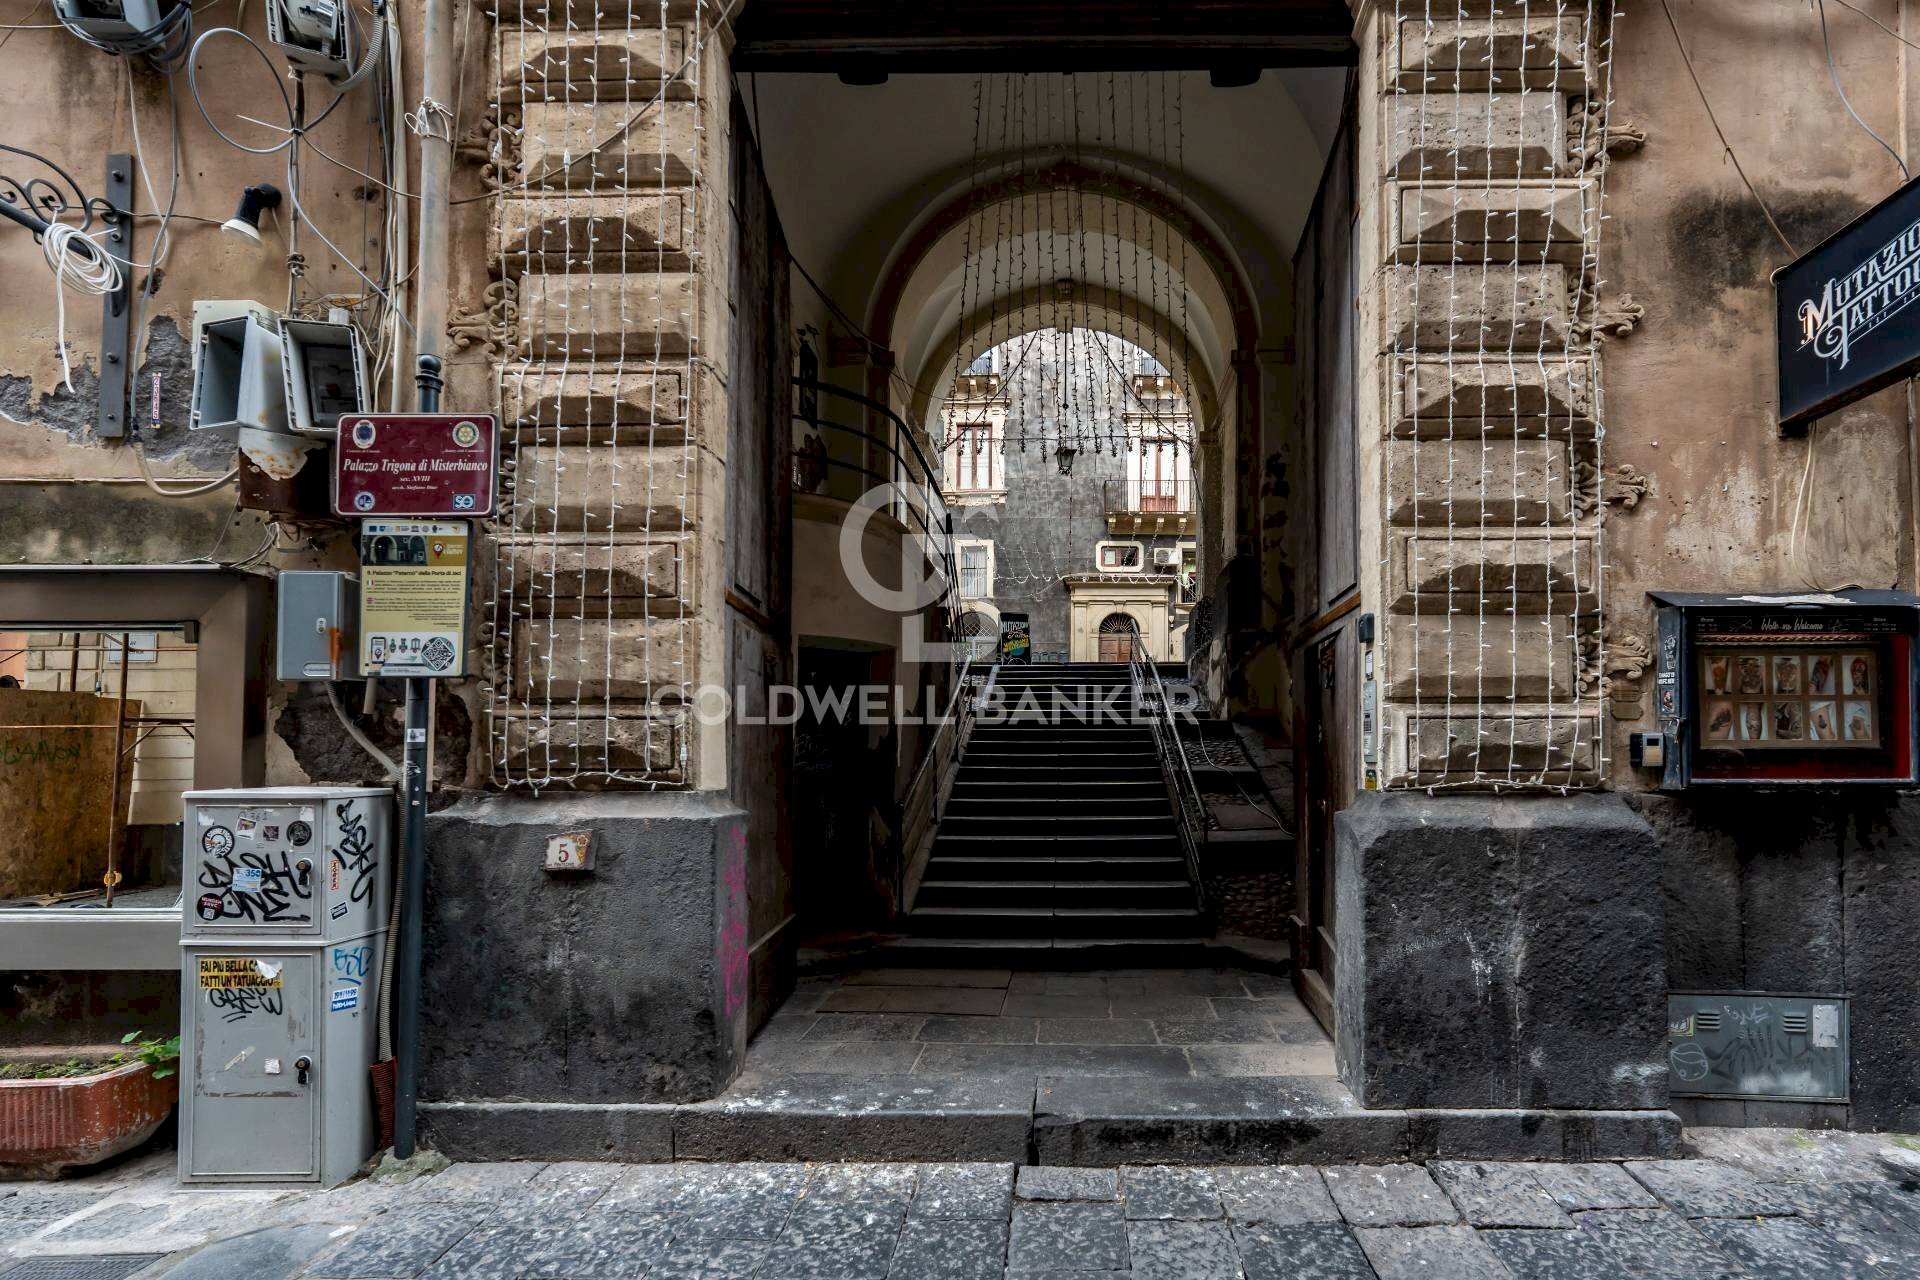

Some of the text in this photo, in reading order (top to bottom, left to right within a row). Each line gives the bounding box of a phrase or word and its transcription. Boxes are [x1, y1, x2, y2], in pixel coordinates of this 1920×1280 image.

[343, 459, 488, 475] Palazzo Trigona di Misterbianco
[412, 474, 430, 482] XVIII
[558, 843, 570, 863] 5
[200, 960, 212, 973] FAI
[226, 960, 248, 973] BELLA
[200, 975, 220, 987] FATTI
[221, 975, 232, 987] UN
